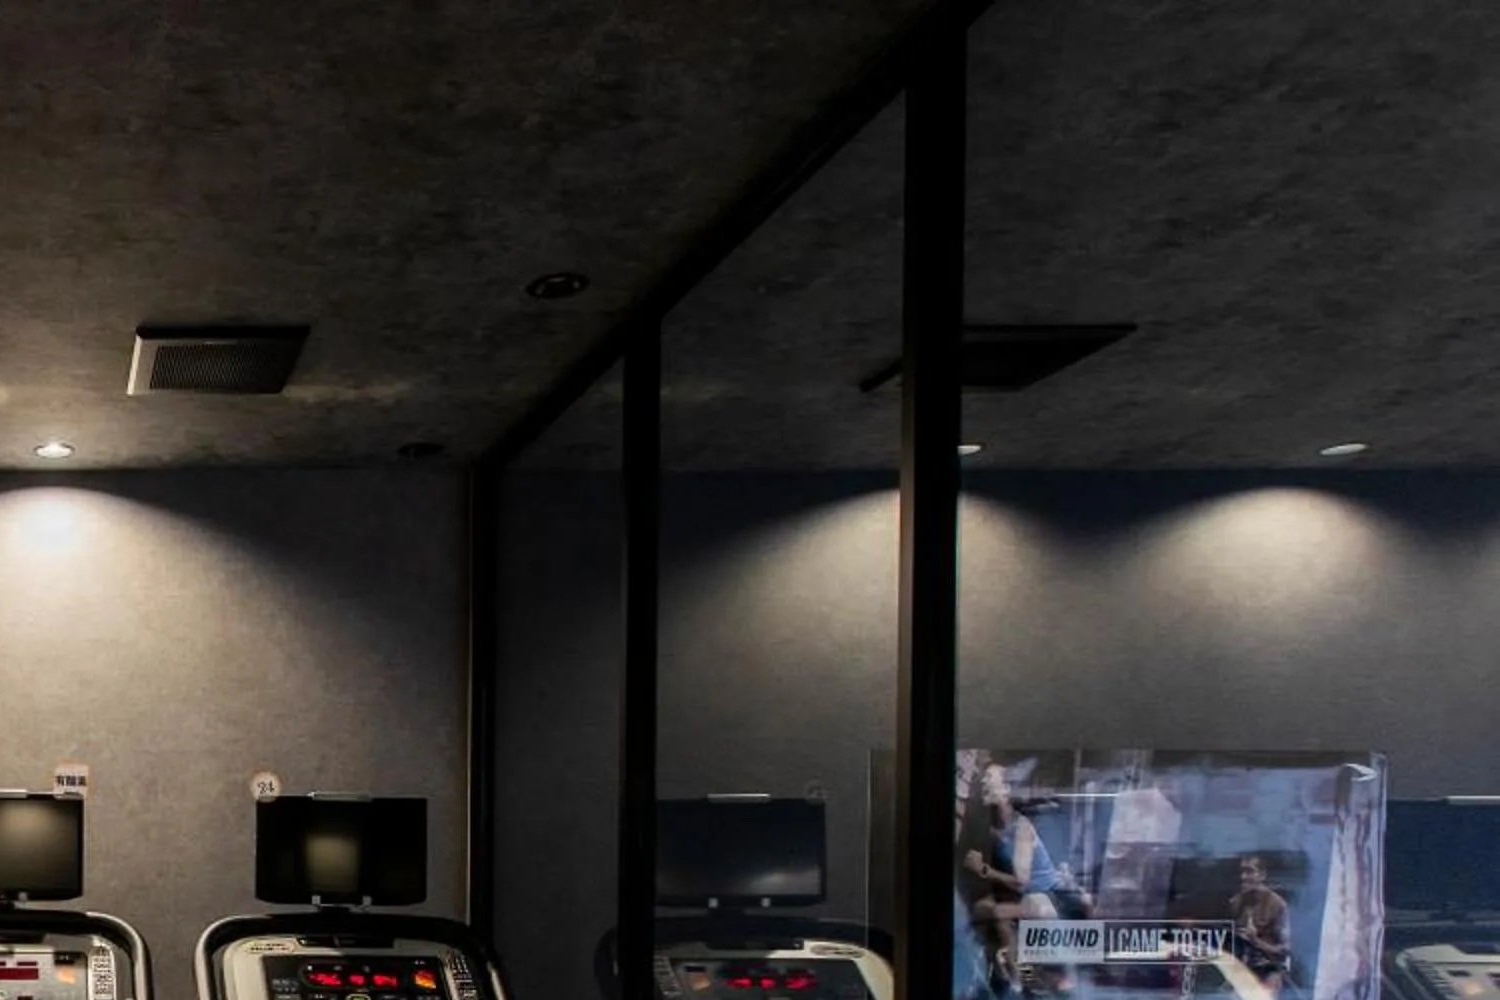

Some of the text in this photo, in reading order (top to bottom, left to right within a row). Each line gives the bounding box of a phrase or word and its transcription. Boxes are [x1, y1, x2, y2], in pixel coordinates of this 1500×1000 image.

[1025, 927, 1099, 947] UBOUND
[1118, 928, 1167, 954] CAME
[1172, 929, 1193, 956] TO
[1197, 929, 1227, 957] FLY
